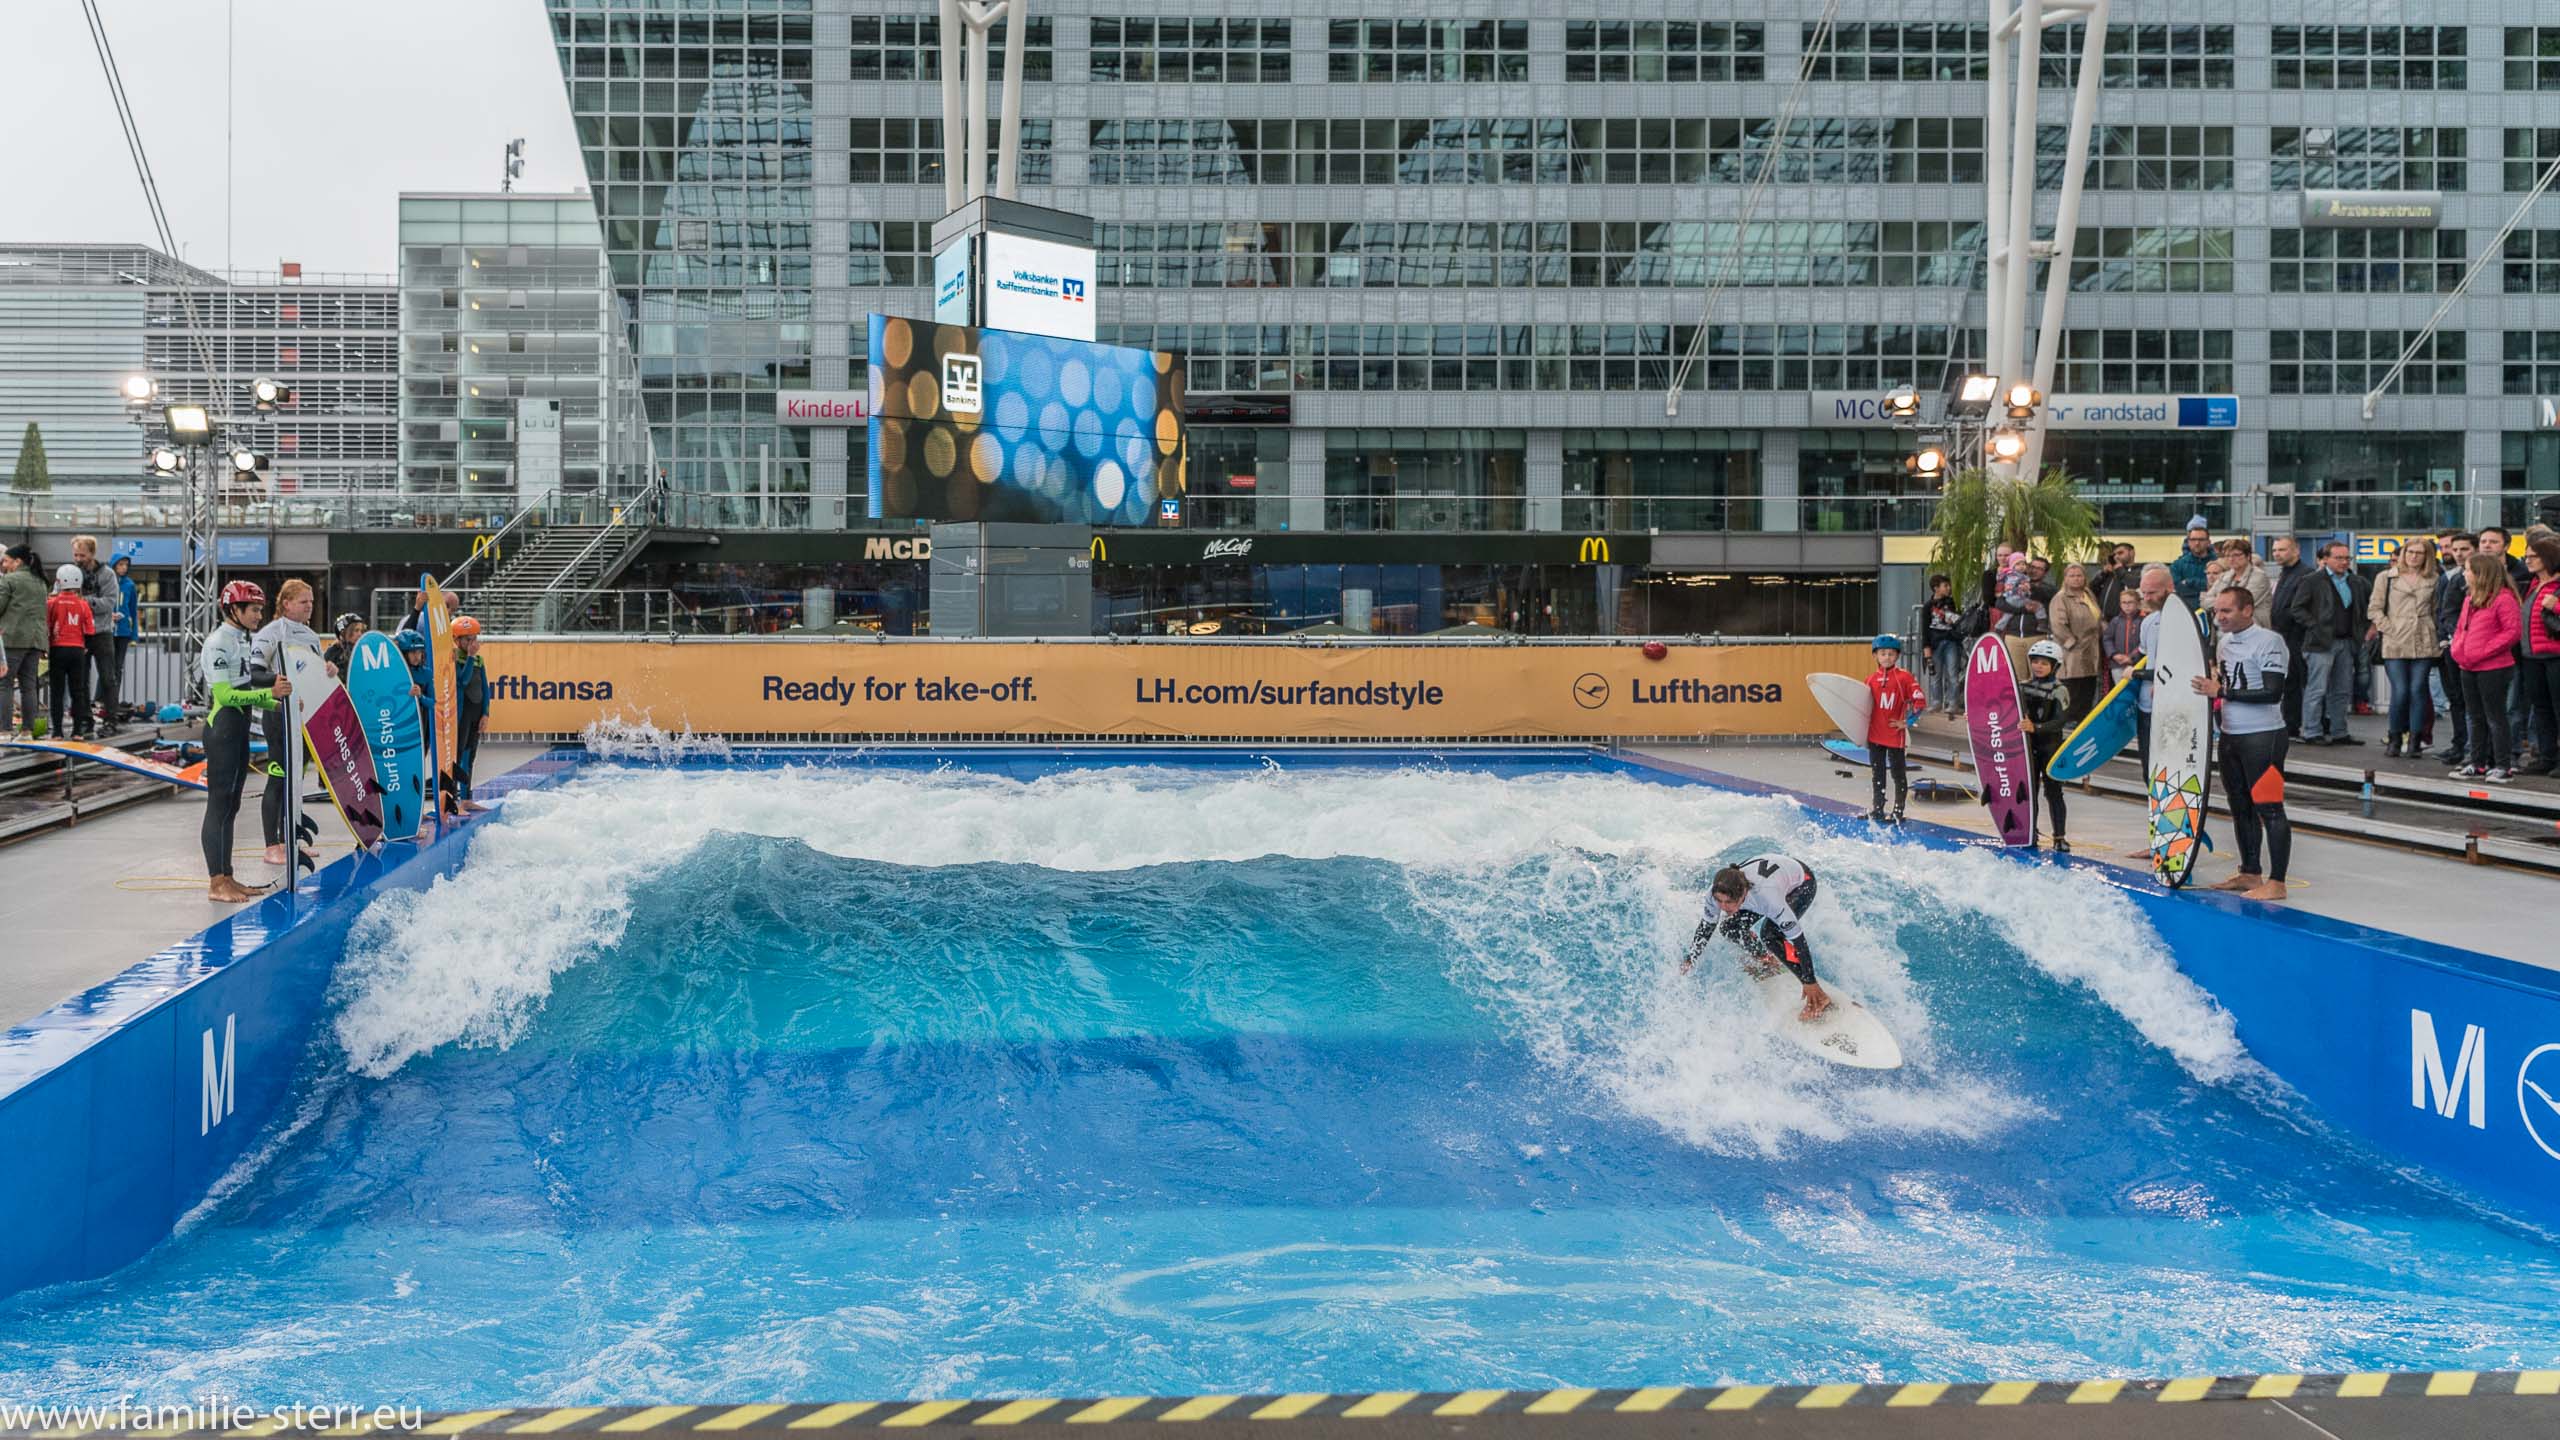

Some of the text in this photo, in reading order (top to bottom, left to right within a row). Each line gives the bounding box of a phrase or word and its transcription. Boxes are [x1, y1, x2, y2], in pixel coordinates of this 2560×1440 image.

[996, 279, 1058, 297] Raiffeisenbanken
[1013, 269, 1058, 285] Volksbanken
[787, 399, 869, 418] KinderL
[946, 394, 977, 407] Banking
[2084, 402, 2167, 421] randstad
[433, 604, 448, 636] M
[361, 641, 391, 671] M
[1976, 645, 1998, 674] M
[490, 675, 613, 702] fthansa
[763, 675, 1037, 706] Ready for take-off.
[1136, 678, 1443, 711] LH.com/surfandstyle
[1632, 678, 1782, 704] Lufthansa
[1880, 692, 1895, 710] M
[333, 725, 366, 801] Surf & Style
[378, 708, 401, 791] Surf & Style
[1987, 711, 2011, 797] Surf & Style
[2073, 737, 2099, 768] M
[202, 1012, 236, 1137] M
[2411, 1007, 2486, 1131] M
